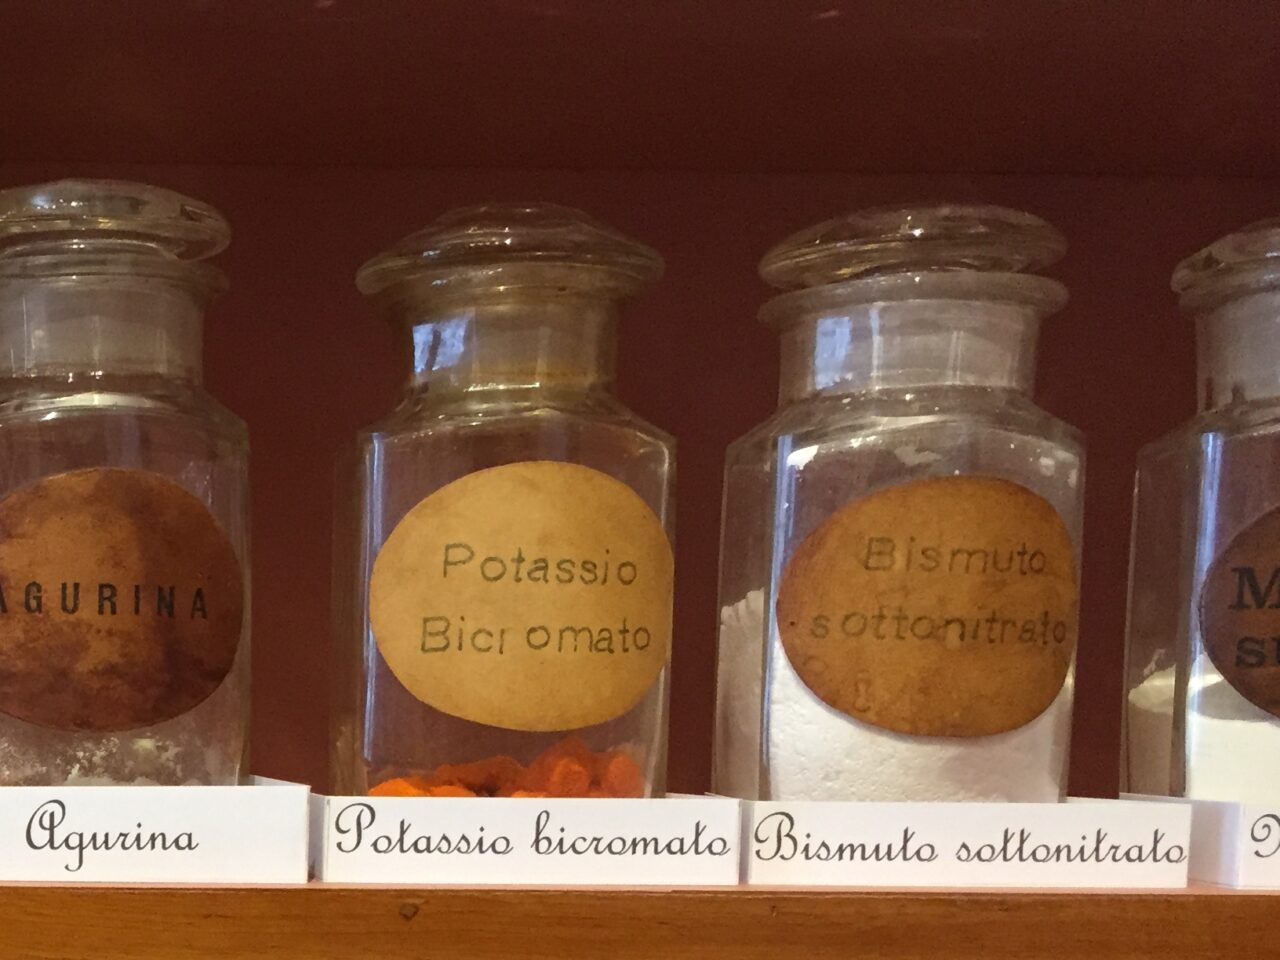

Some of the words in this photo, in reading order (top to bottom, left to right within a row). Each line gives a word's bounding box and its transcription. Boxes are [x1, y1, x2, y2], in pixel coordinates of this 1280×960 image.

[442, 541, 639, 585] Potassio
[862, 536, 1048, 577] Bismuto
[420, 615, 652, 656] Bicromato
[809, 609, 1067, 645] sottonitrato
[25, 798, 200, 873] Agurina
[334, 802, 515, 856] Potassio
[530, 809, 732, 857] bicromato
[753, 810, 939, 864] Bismuto
[955, 827, 1187, 864] sottonitrato
